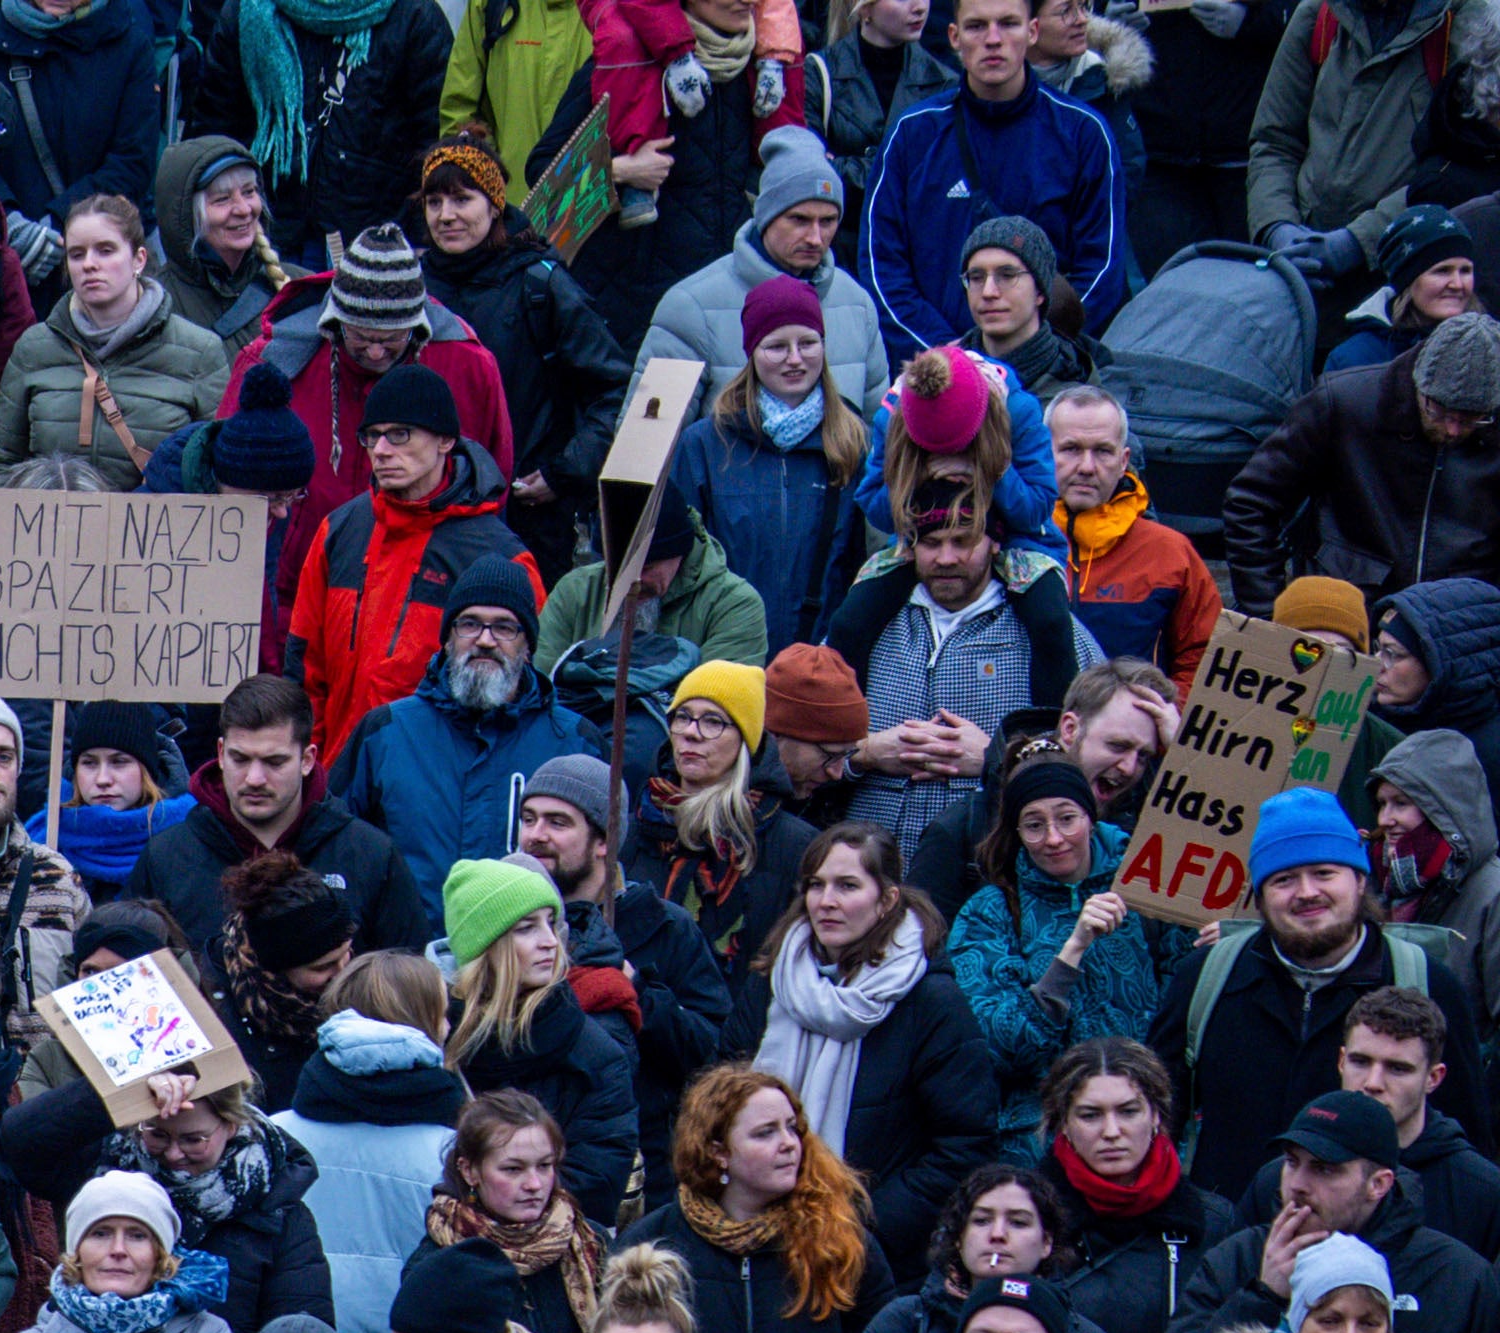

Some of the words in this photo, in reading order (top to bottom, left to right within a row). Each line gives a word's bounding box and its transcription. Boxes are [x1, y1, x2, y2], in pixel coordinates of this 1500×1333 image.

[12, 502, 102, 558] MIT
[121, 502, 244, 563] NAZIS
[133, 621, 260, 687] KAPIERT
[1204, 647, 1307, 715] Herz
[1316, 675, 1374, 741] auf
[1178, 704, 1274, 772] Hirn
[1290, 747, 1330, 782] an
[1151, 770, 1244, 836] Hass
[1121, 832, 1246, 910] AFD
